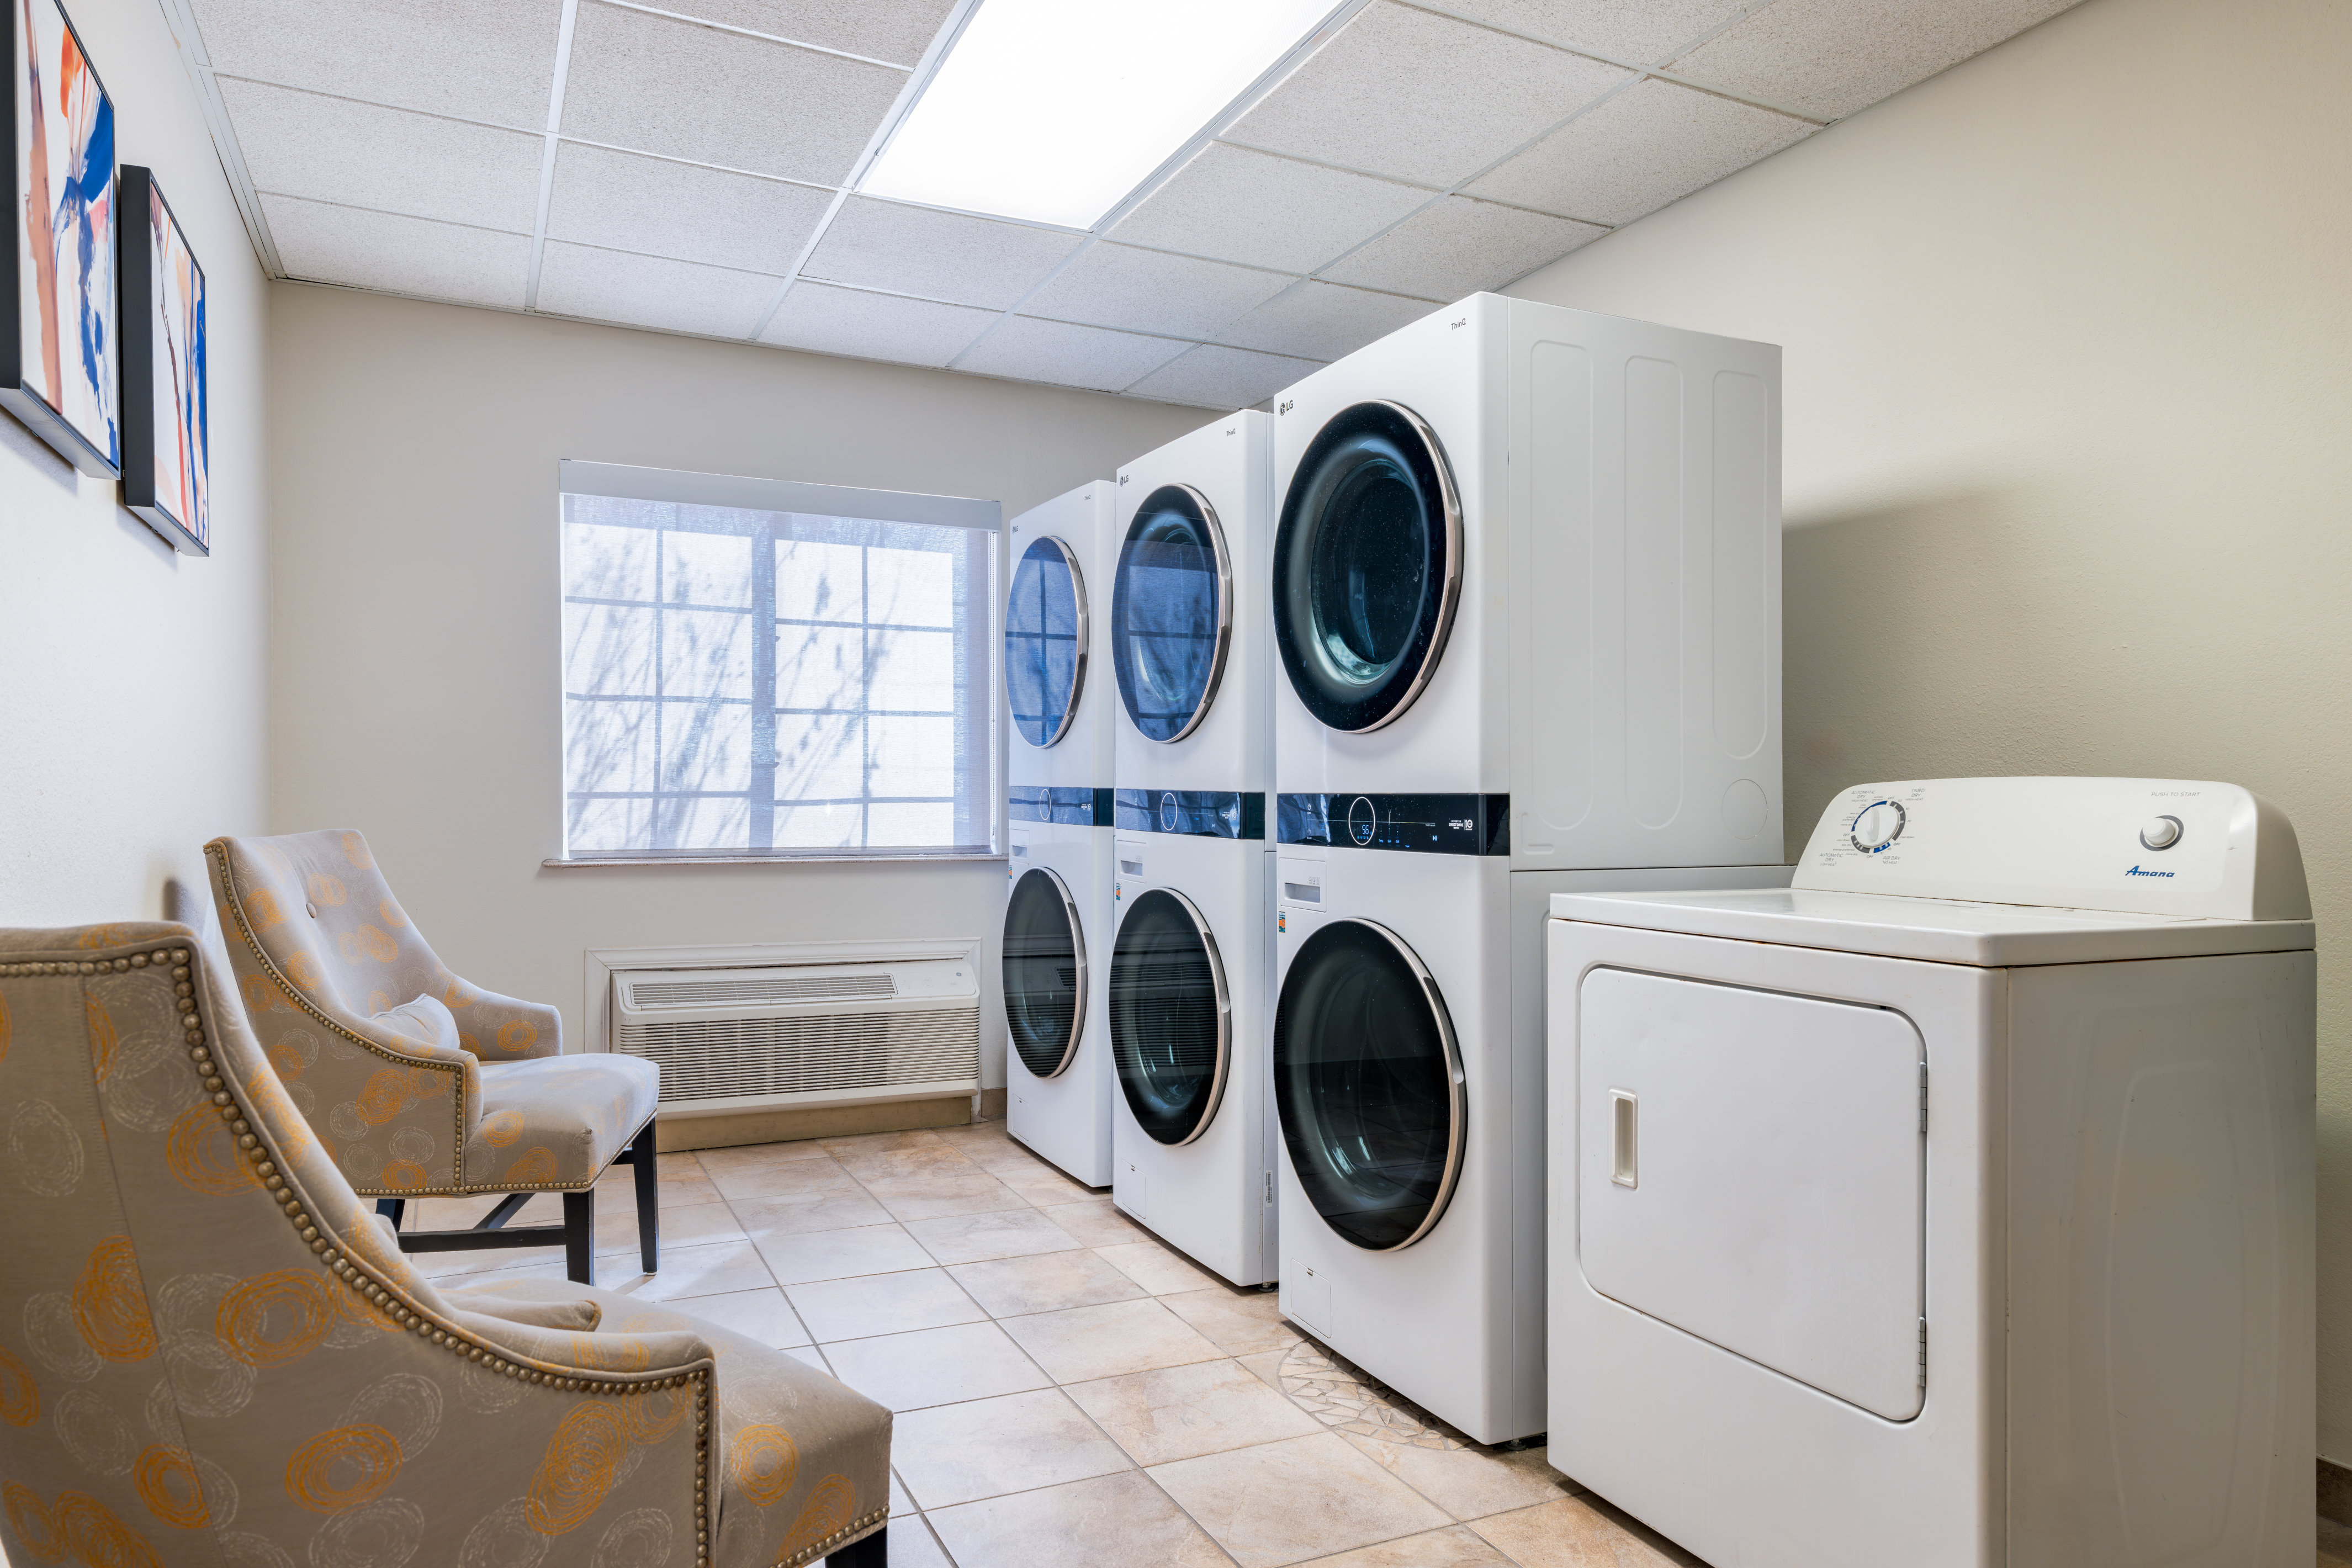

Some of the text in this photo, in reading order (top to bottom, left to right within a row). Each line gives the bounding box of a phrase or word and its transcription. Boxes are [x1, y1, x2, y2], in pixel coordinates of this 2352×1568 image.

[1451, 318, 1466, 330] ThinQ
[1226, 428, 1236, 436] ThinQ
[2125, 865, 2175, 877] Amana
